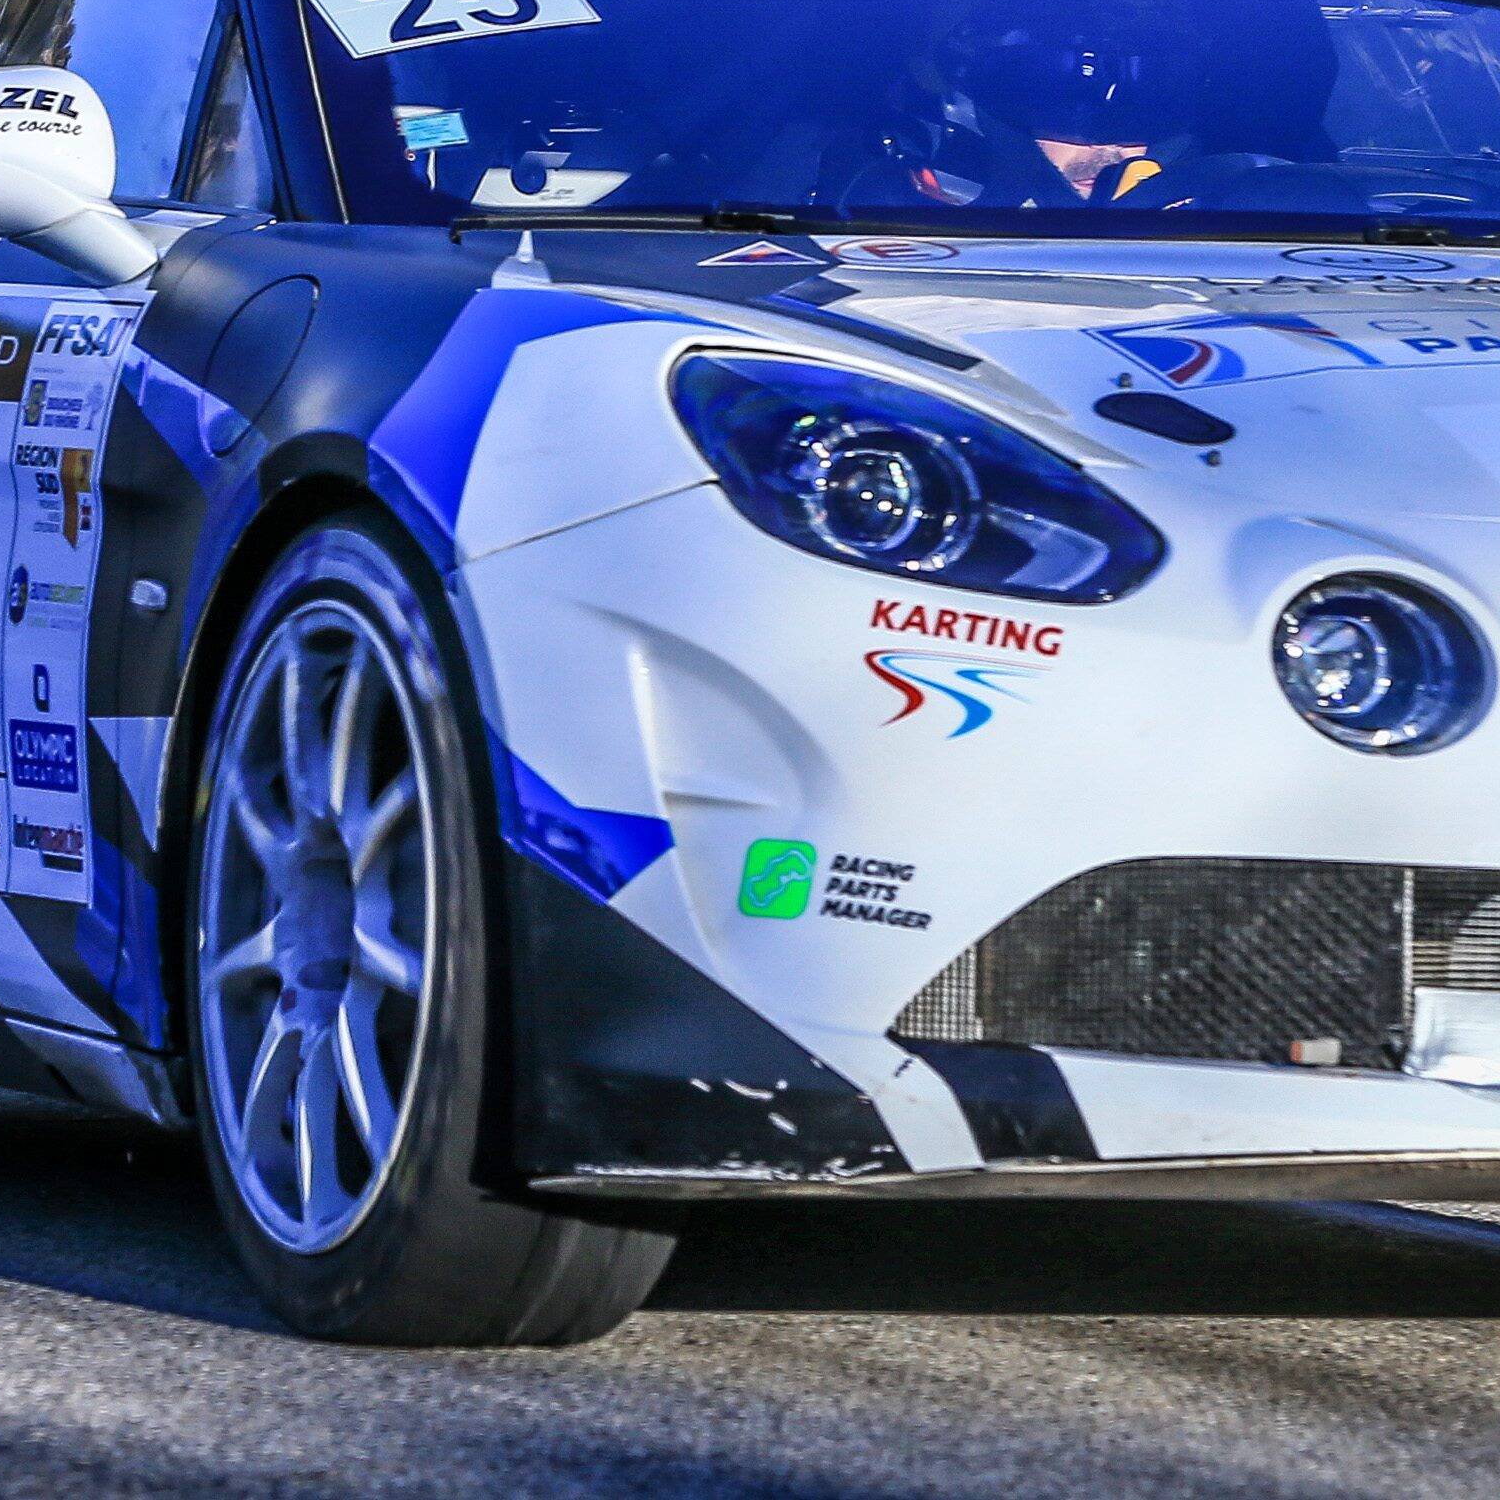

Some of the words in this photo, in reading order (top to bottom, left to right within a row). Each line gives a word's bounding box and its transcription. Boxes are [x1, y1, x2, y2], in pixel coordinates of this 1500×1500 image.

[17, 120, 83, 136] course
[870, 599, 1065, 656] KARTING
[830, 854, 916, 882] RACING
[824, 877, 899, 902] PARTS
[820, 899, 933, 930] MANAGER
